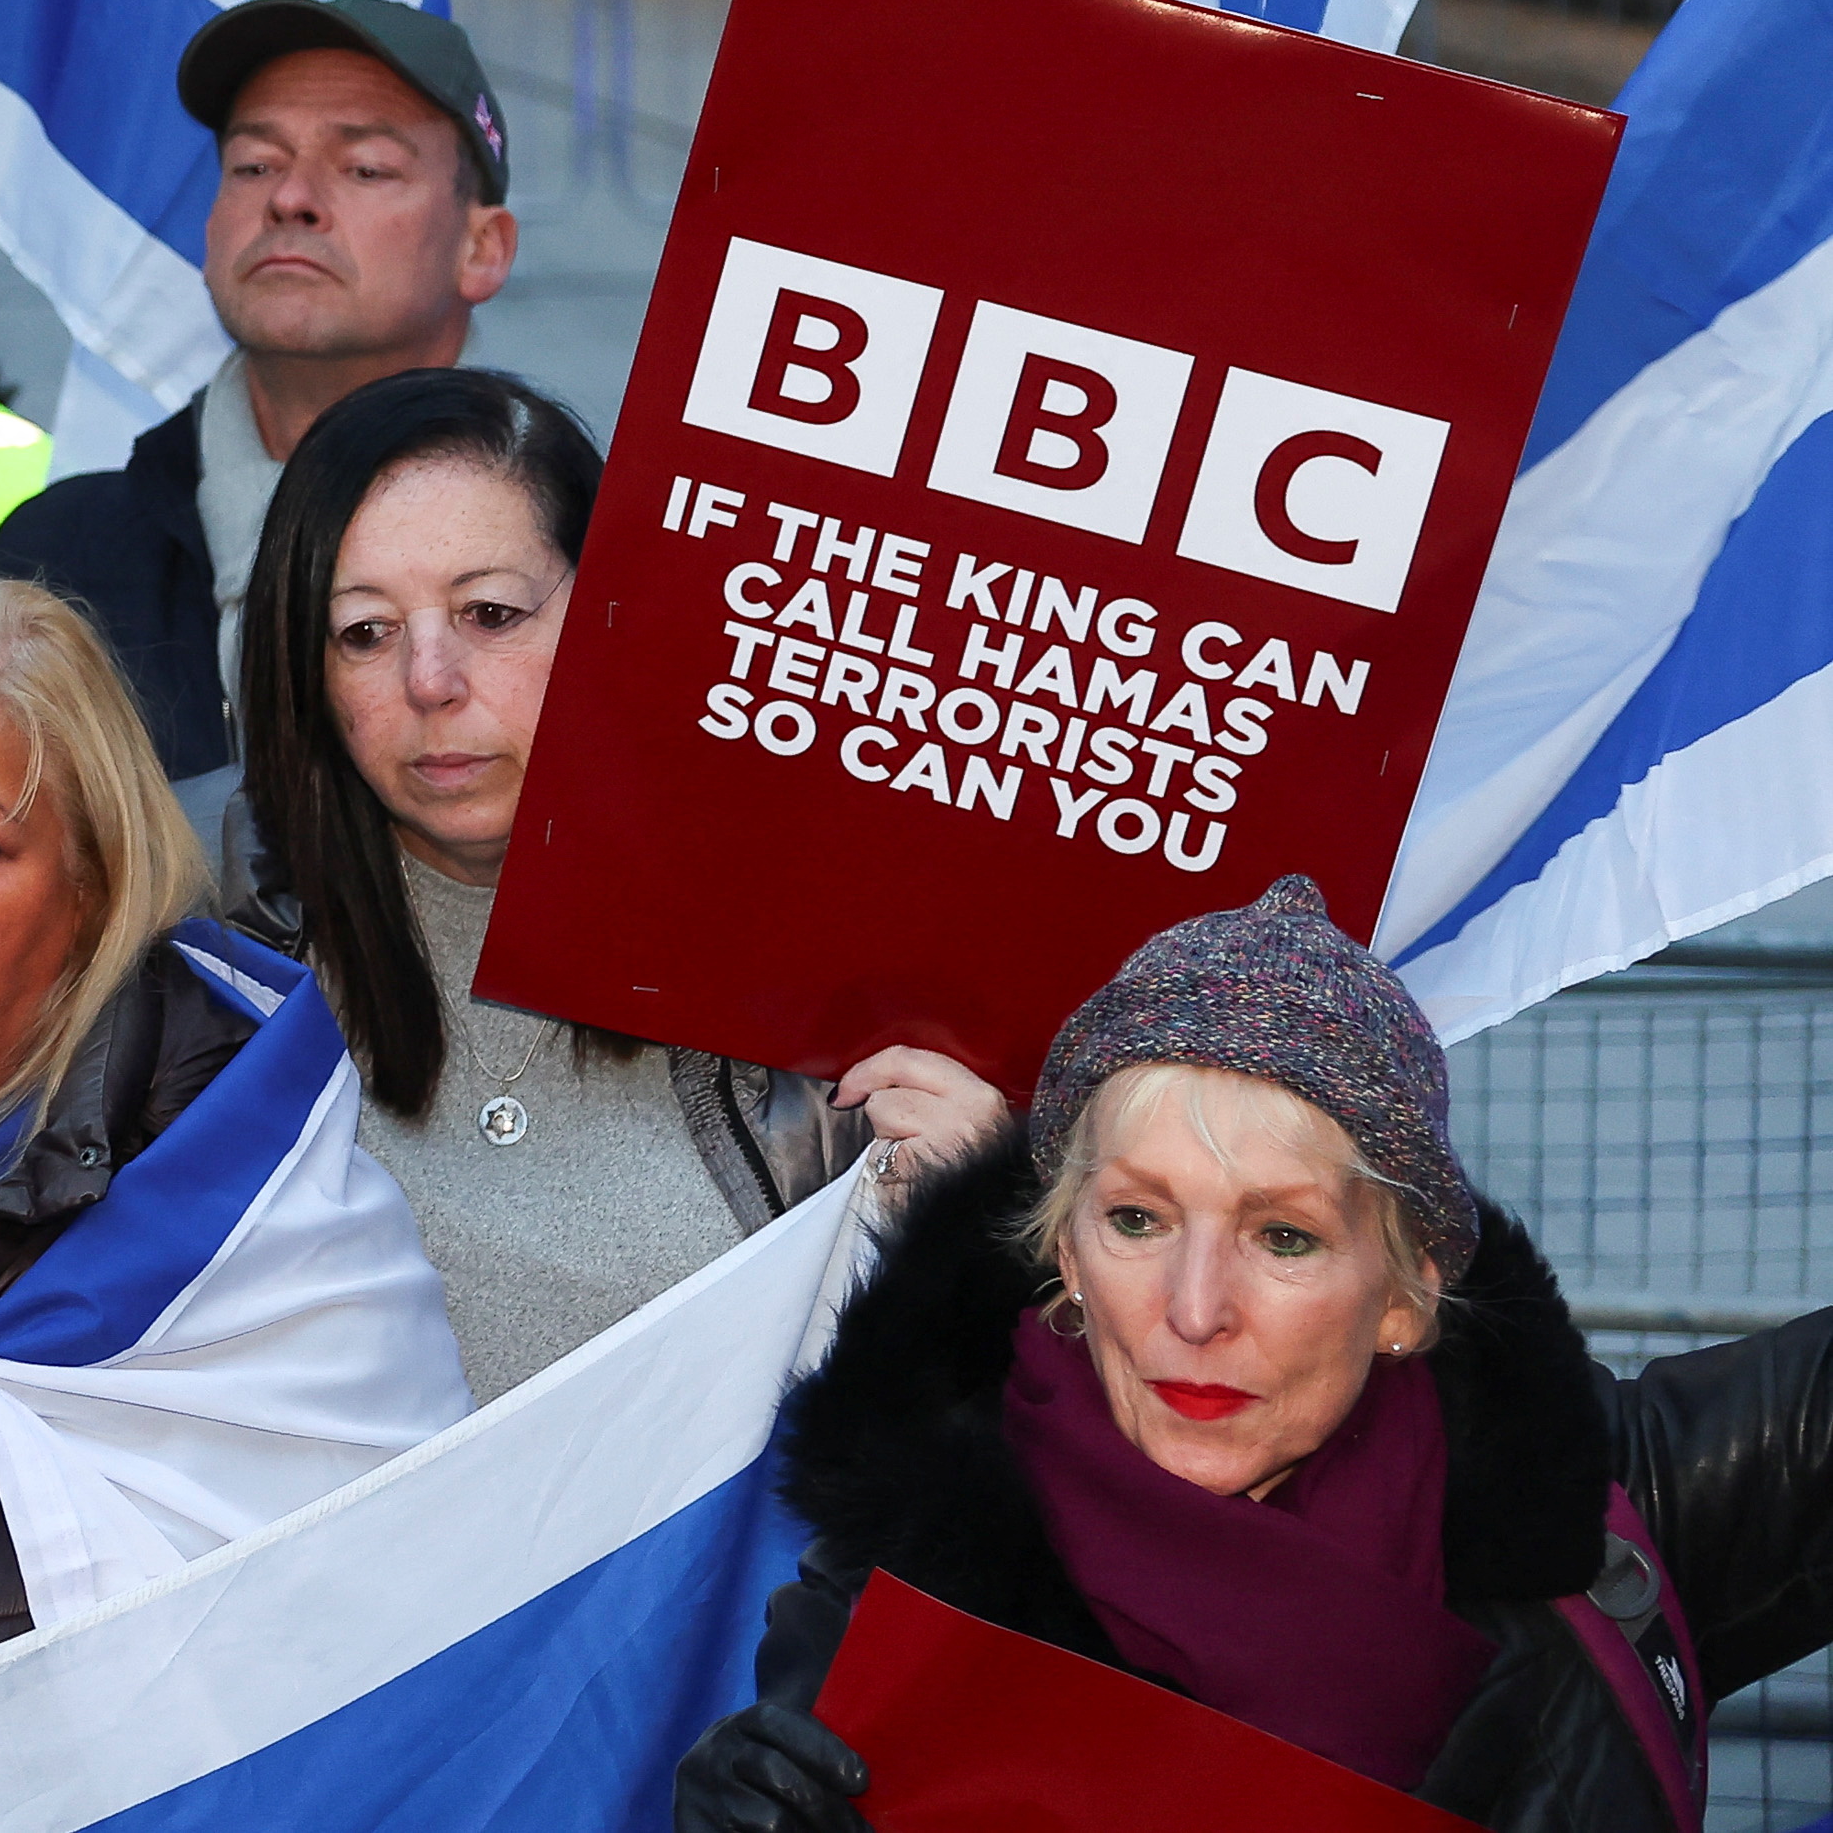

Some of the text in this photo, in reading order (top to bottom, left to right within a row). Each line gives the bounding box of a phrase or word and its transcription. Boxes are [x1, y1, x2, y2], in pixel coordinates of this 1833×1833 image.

[746, 287, 1382, 564] BBC
[662, 474, 1371, 714] IF THE KING CAN
[723, 562, 1270, 755] CALL HAMAS
[697, 680, 1228, 873] SO CAN YOU
[723, 620, 1243, 813] TERRORISTS
